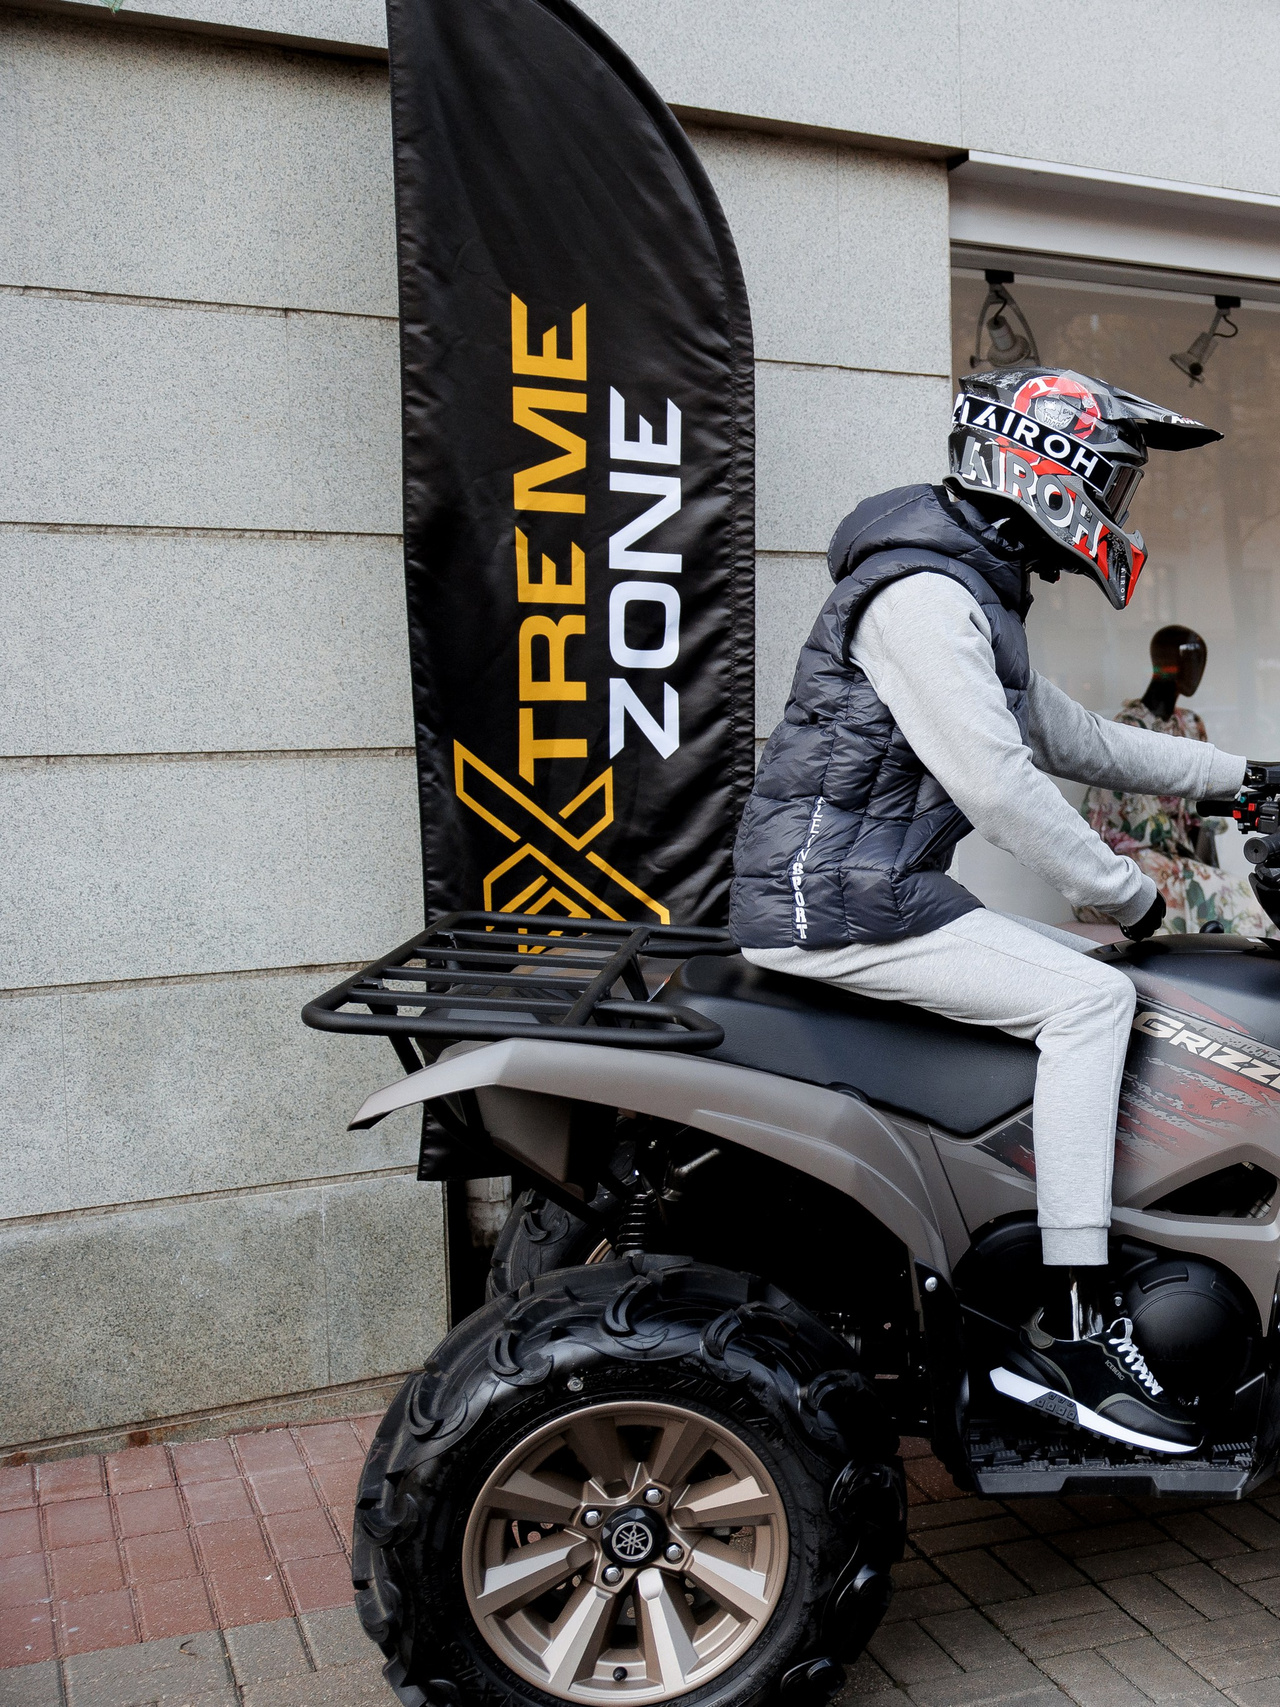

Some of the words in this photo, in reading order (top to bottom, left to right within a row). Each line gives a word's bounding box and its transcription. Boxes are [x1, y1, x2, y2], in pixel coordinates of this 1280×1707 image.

[972, 404, 1099, 478] AIROH
[960, 436, 1103, 558] AIROH
[608, 386, 682, 760] ZONE
[792, 862, 808, 940] SPORT
[1104, 1359, 1126, 1381] ICEBERG
